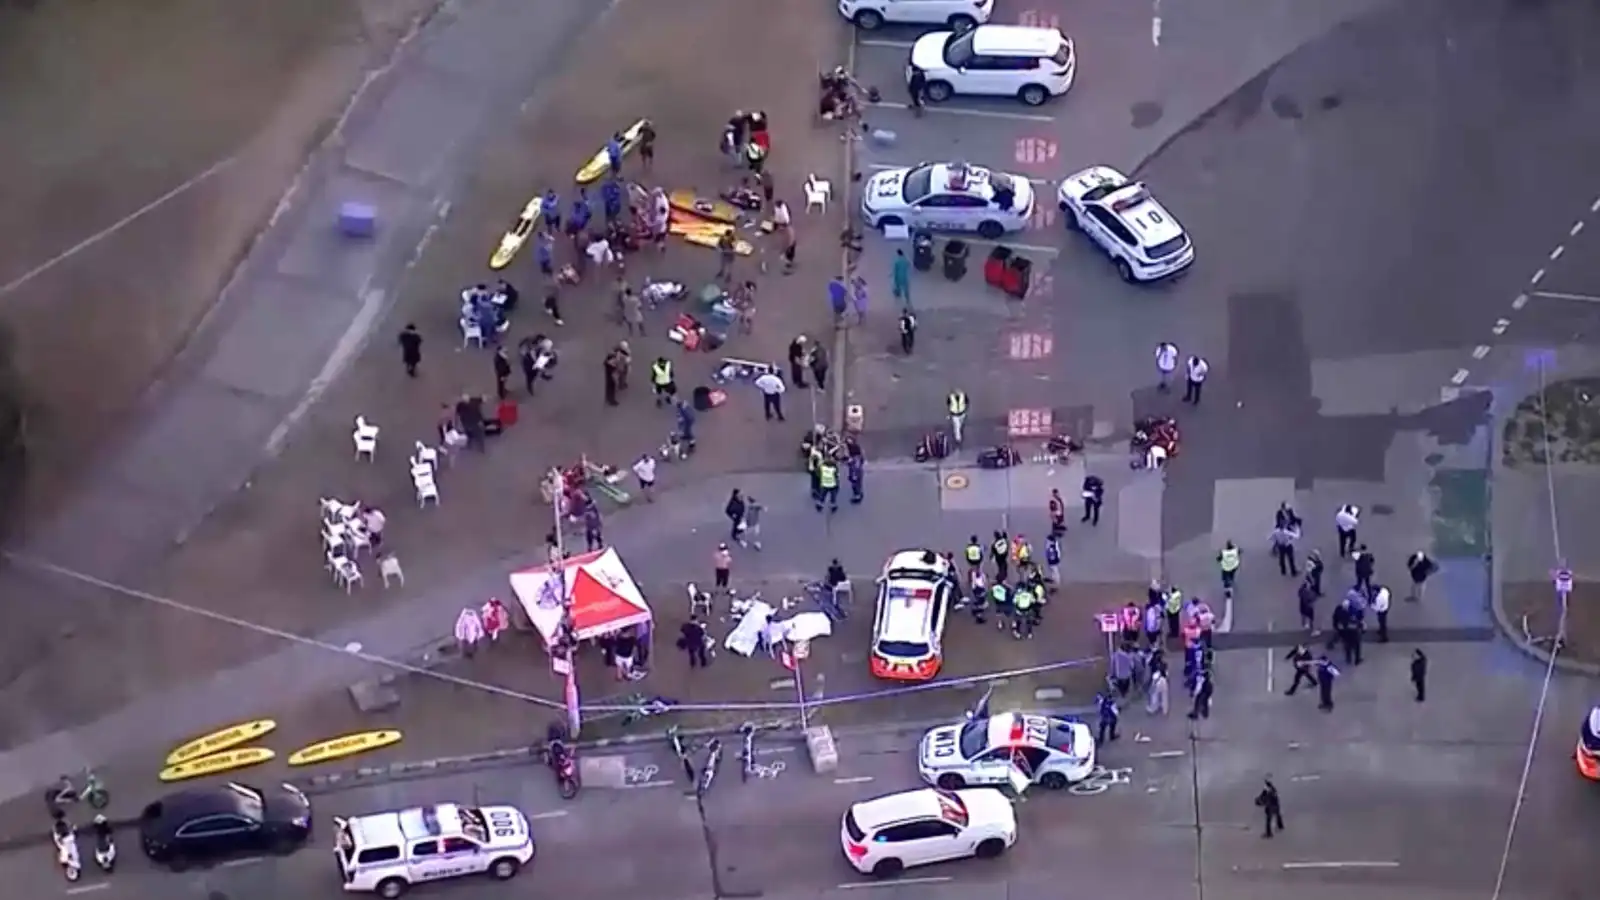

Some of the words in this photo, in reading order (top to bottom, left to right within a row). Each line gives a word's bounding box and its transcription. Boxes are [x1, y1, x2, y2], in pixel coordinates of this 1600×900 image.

[1134, 210, 1163, 231] 10
[1026, 717, 1048, 743] 720
[489, 811, 515, 837] 900
